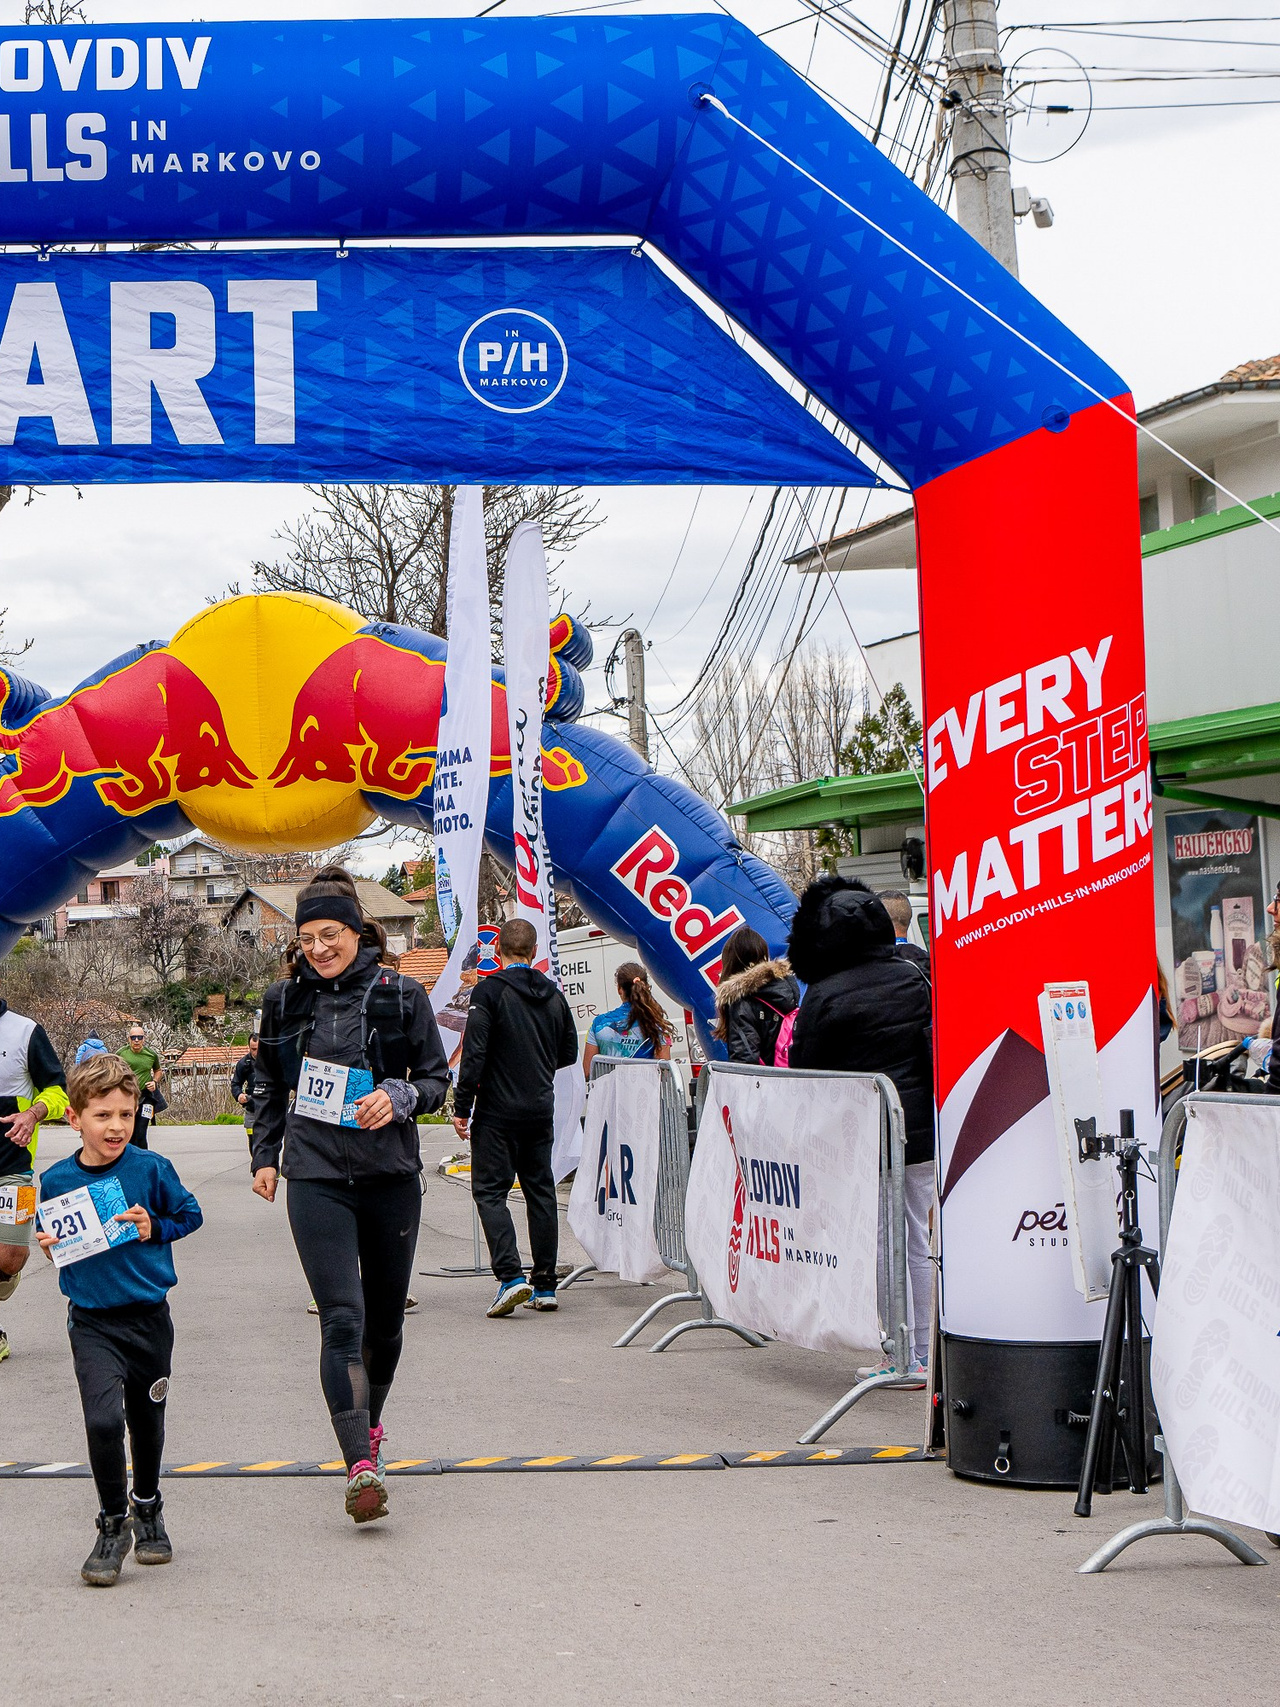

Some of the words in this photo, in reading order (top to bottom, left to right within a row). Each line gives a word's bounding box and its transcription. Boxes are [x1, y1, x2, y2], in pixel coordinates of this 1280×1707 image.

[131, 120, 167, 141] IN
[131, 151, 321, 173] MARKOVO
[479, 342, 547, 375] P/H
[928, 635, 1113, 794] EVERY
[1014, 691, 1147, 816] STEP
[1188, 863, 1240, 876] www.nashensko.bg
[615, 828, 742, 958] Red
[955, 852, 1151, 949] WWW.PLOVDIV-HILLS-IN-MARKOVO.COM
[308, 1076, 335, 1100] 137
[51, 1210, 87, 1240] 231
[784, 1227, 794, 1241] IN
[785, 1248, 838, 1269] MARKOVO
